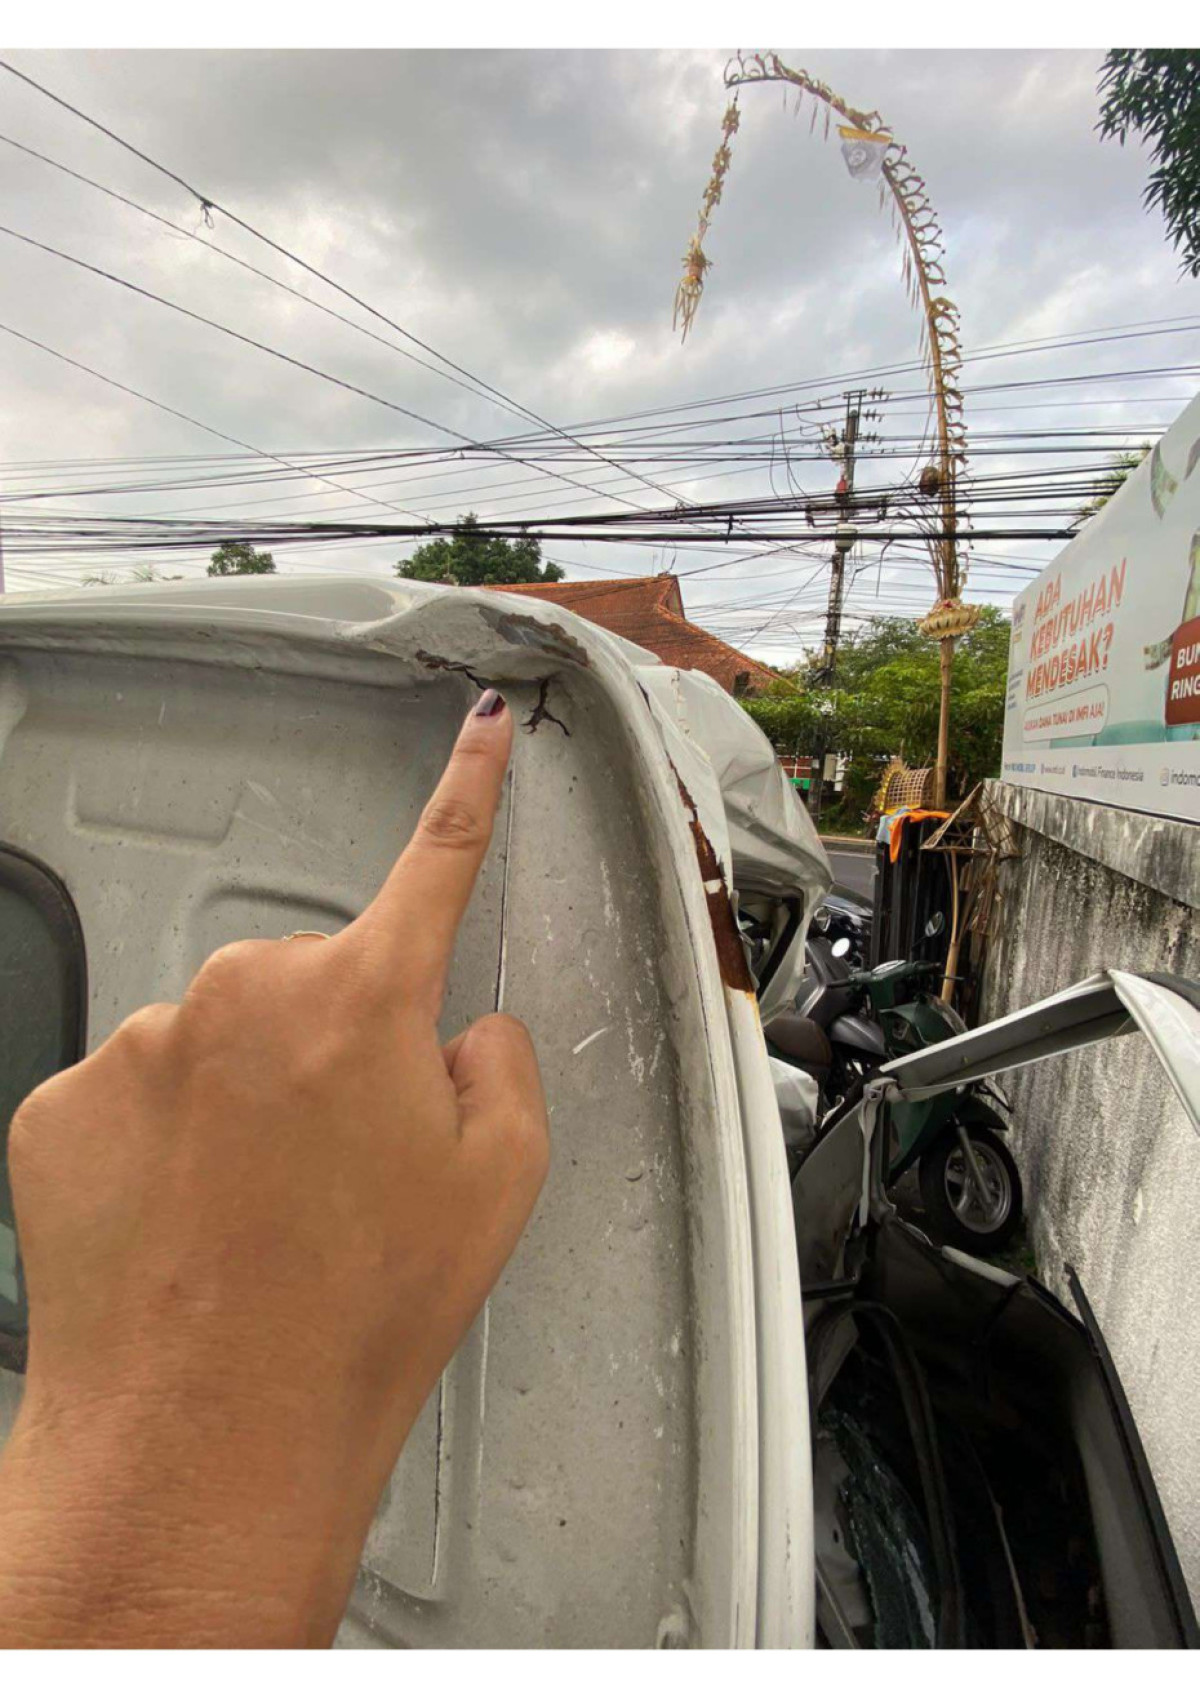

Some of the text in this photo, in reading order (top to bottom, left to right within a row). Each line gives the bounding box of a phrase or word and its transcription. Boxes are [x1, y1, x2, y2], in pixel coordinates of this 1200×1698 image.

[1029, 557, 1127, 663] KEBUTUHAN
[1034, 573, 1062, 621] ADA
[1025, 622, 1114, 701] MENDESAK?
